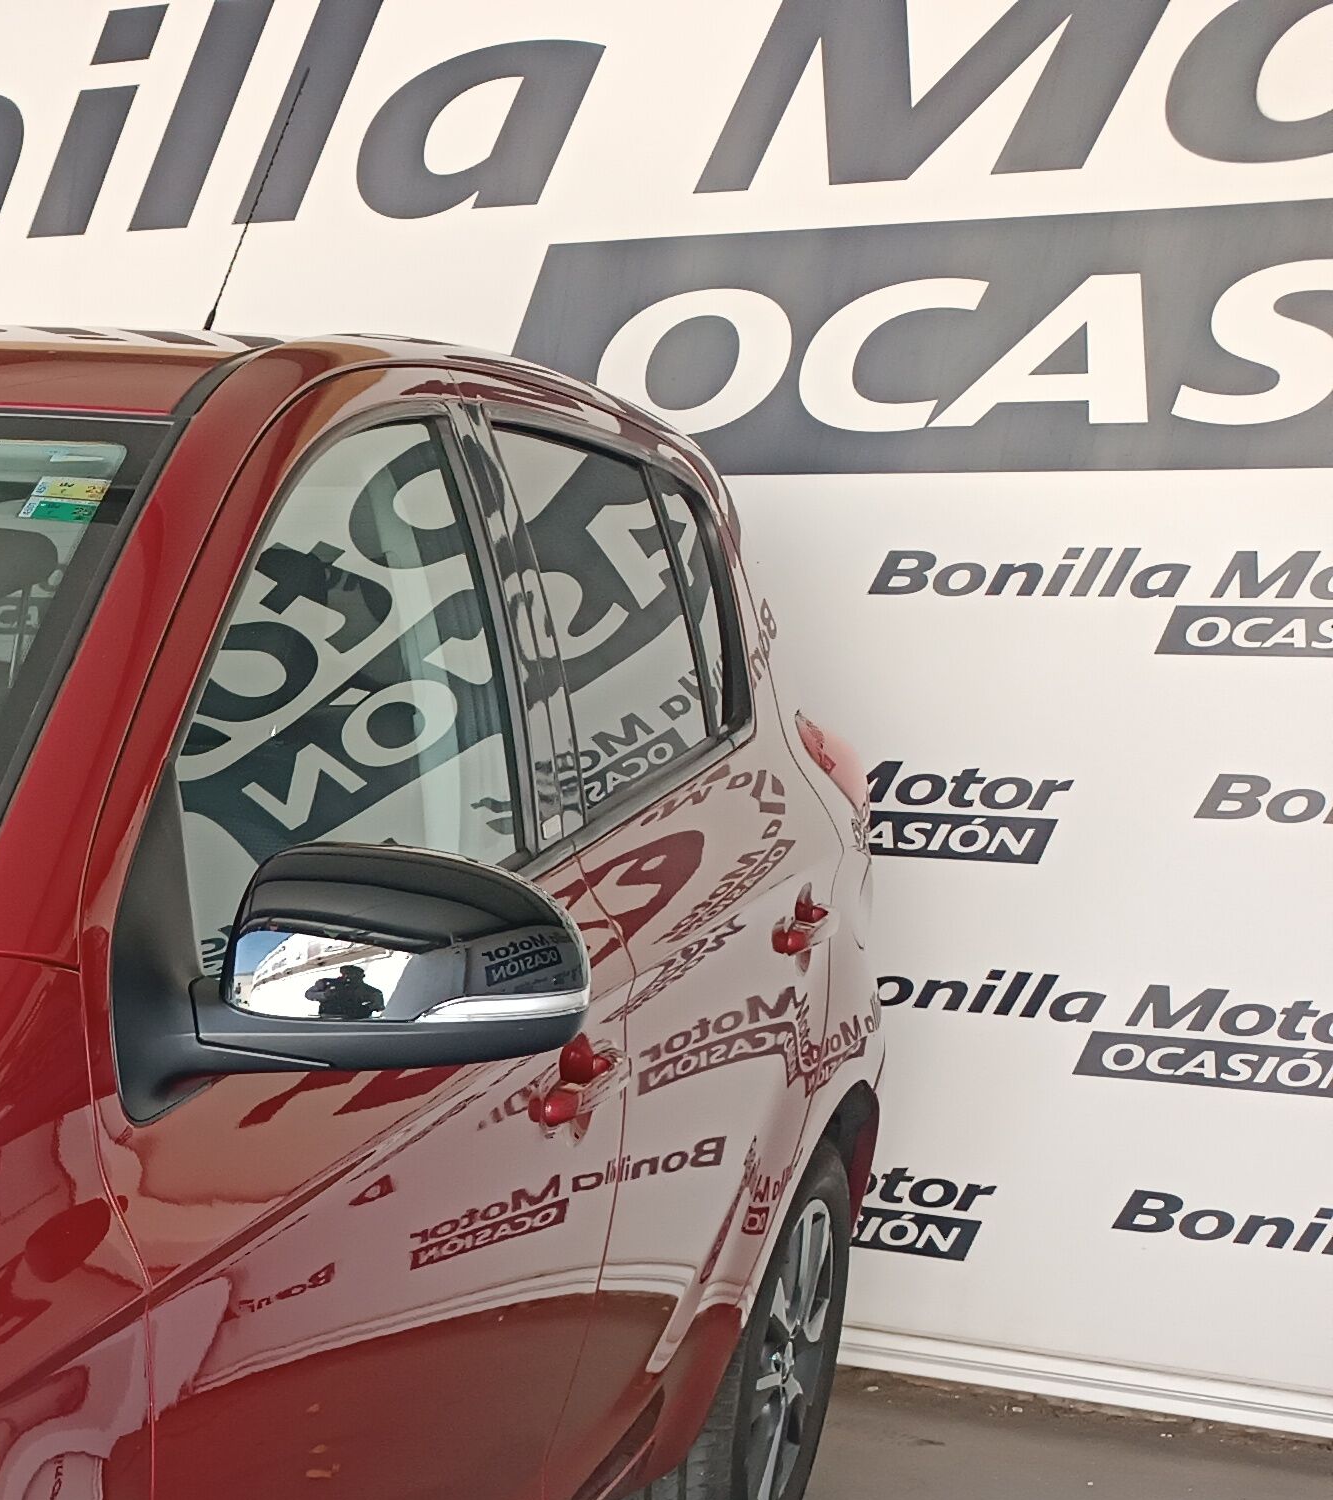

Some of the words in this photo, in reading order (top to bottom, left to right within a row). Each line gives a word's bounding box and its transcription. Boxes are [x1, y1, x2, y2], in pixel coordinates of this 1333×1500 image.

[868, 547, 1191, 599] Bonilla
[1193, 773, 1333, 825] Bo
[877, 969, 1107, 1024] onilla
[1101, 1043, 1333, 1089] OCASIÓ
[853, 1213, 961, 1252] IÓN
[1112, 1189, 1333, 1256] Boni
